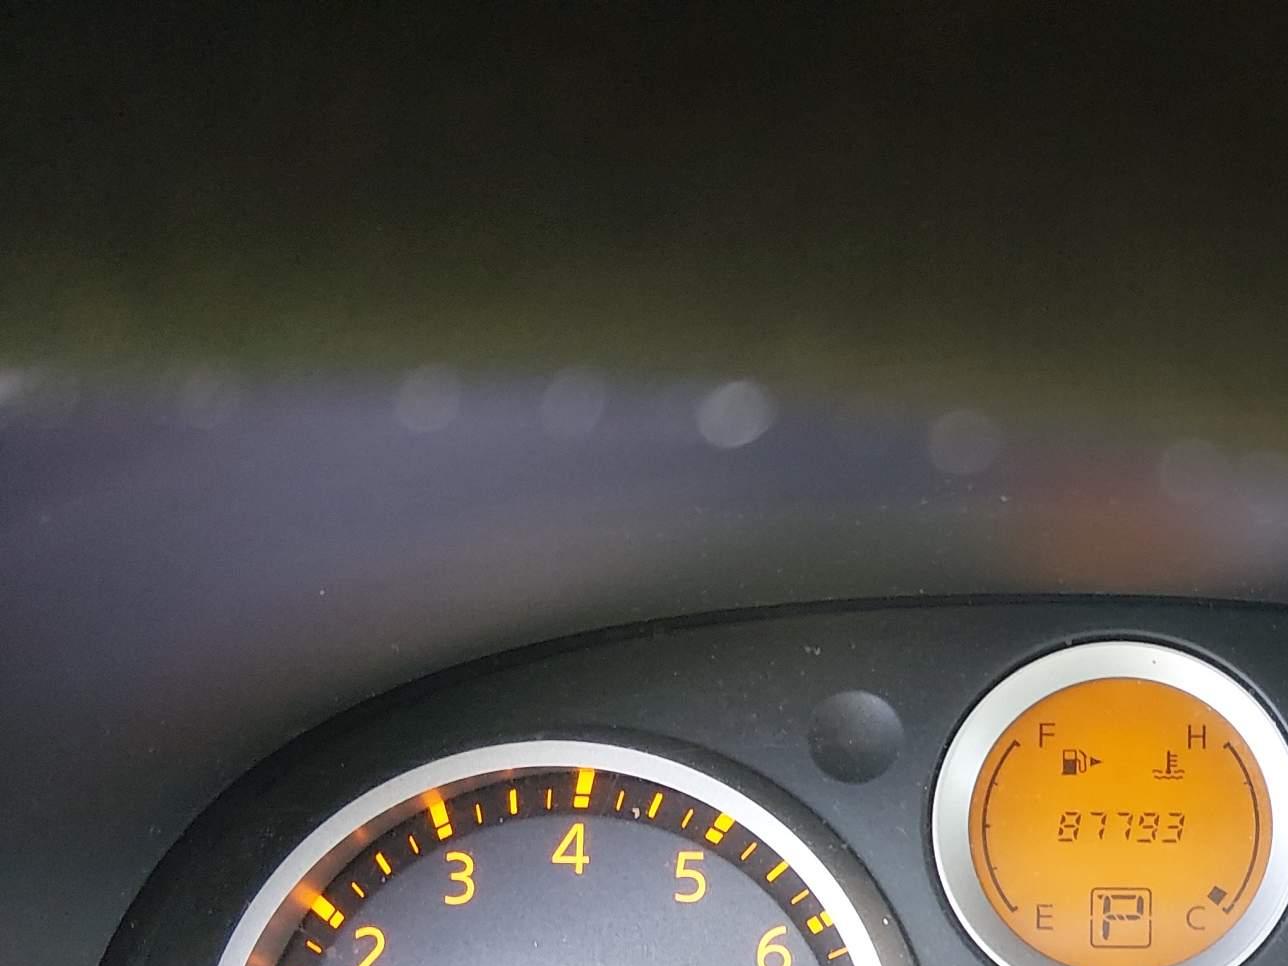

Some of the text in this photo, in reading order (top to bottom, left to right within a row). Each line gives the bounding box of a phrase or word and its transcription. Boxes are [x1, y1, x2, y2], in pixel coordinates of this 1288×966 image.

[1038, 722, 1055, 747] F
[1188, 724, 1207, 749] H
[1058, 811, 1187, 842] 87793
[552, 822, 589, 874] 4
[444, 853, 476, 905] 3
[674, 852, 707, 903] 5
[1036, 905, 1053, 930] E
[1097, 894, 1142, 940] P
[1186, 905, 1206, 931] C
